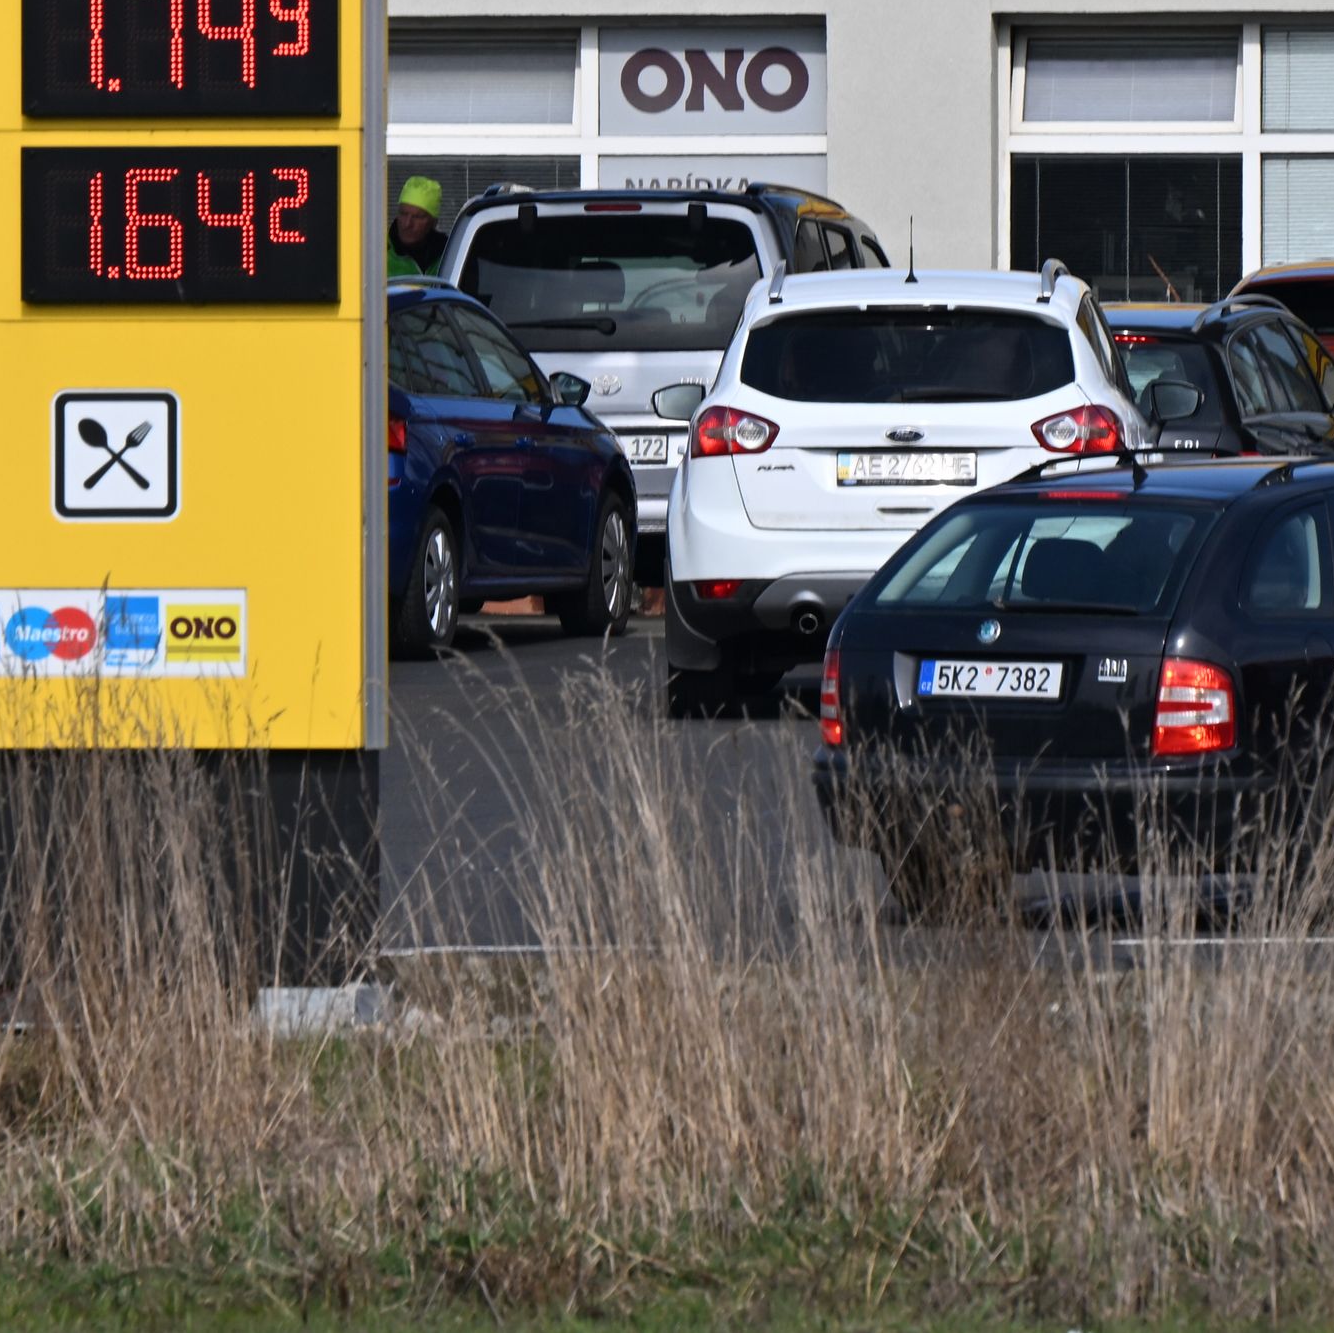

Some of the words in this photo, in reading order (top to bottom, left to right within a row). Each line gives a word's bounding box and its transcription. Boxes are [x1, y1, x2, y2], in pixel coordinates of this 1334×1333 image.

[620, 46, 809, 113] ONO
[631, 438, 664, 456] 172
[15, 625, 89, 643] Maestro
[170, 616, 237, 640] ONO
[938, 665, 979, 691] 5K2
[996, 667, 1051, 693] 7382
